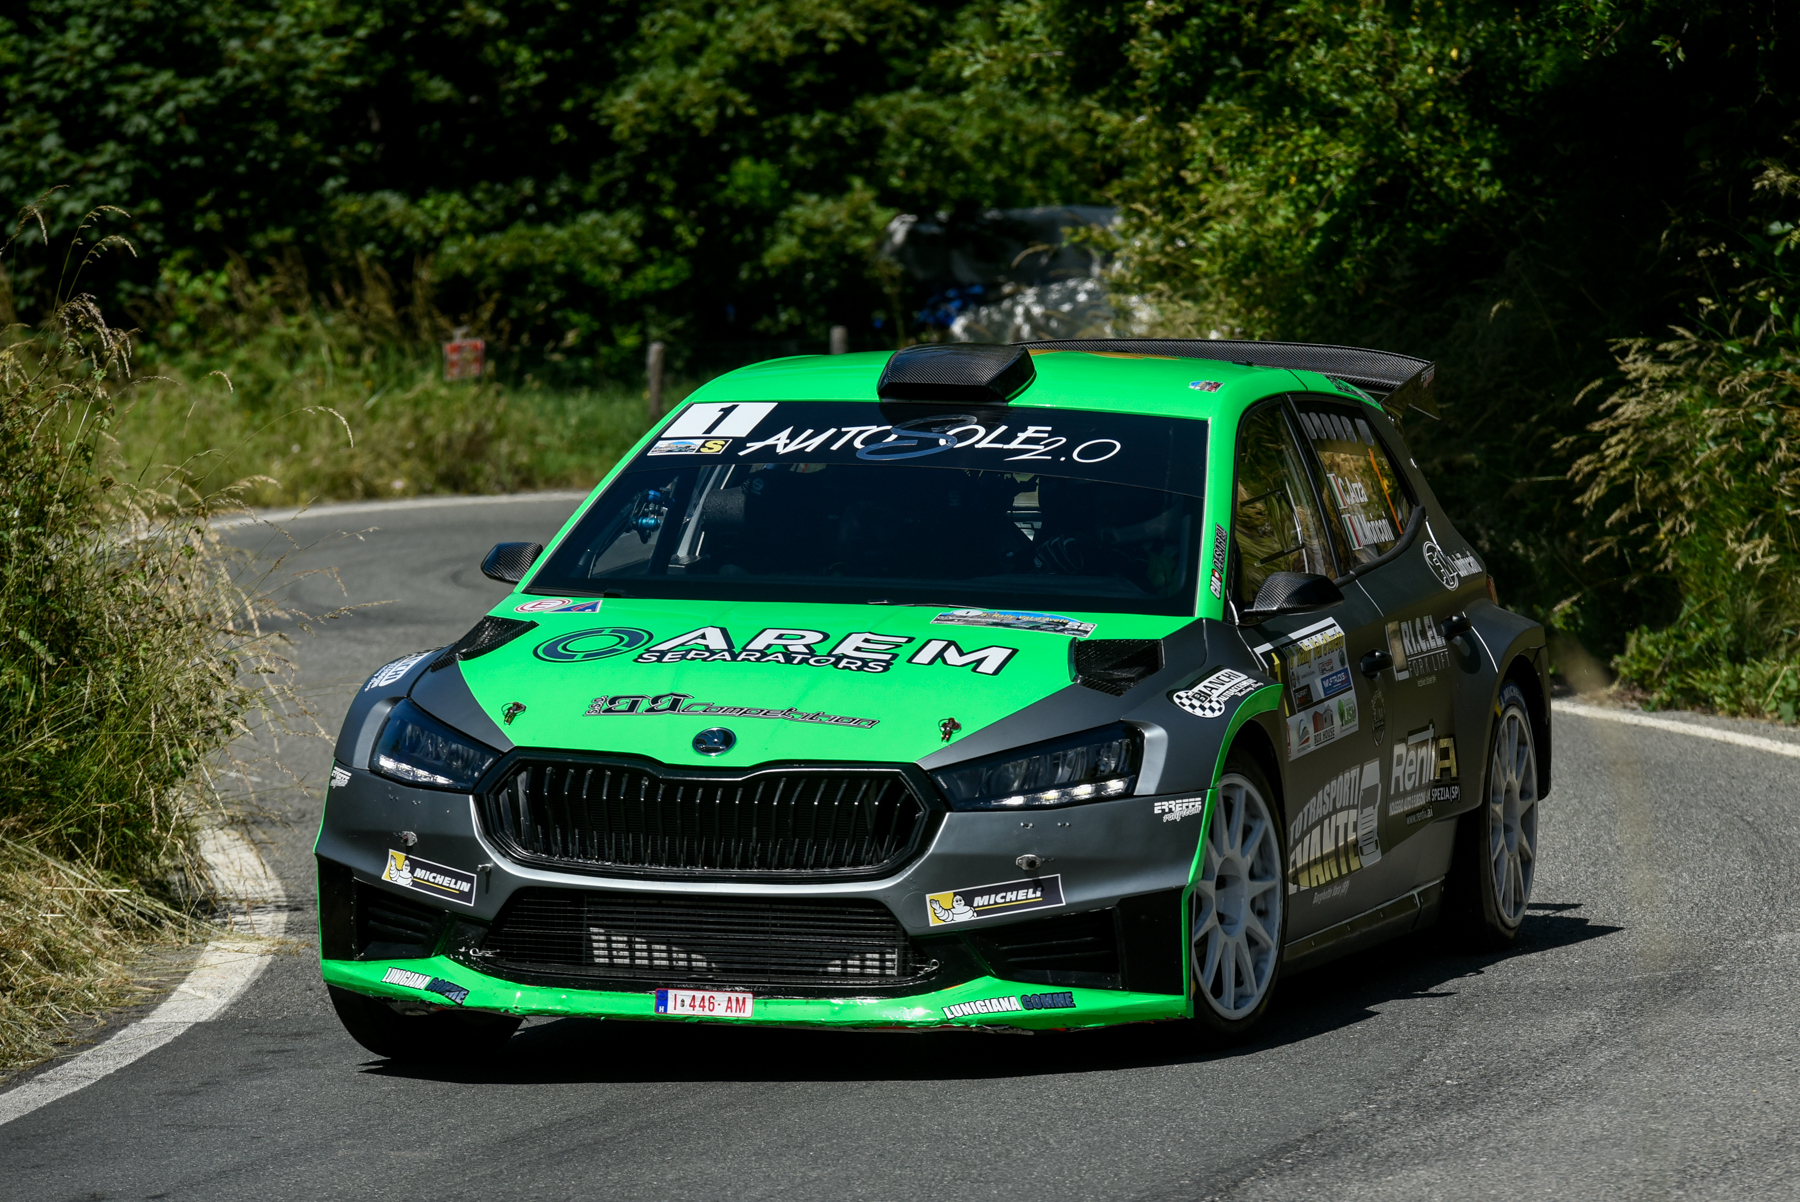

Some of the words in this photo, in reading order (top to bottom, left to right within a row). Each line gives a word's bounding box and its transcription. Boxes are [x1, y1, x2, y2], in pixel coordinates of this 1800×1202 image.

[702, 403, 741, 435] 1
[700, 440, 726, 453] S
[633, 649, 891, 674] SEPARATORS
[645, 626, 1018, 675] AREM
[1408, 656, 1431, 678] FORK
[1191, 671, 1242, 703] BIANCHI
[413, 868, 472, 893] MICHELIN
[381, 966, 432, 990] LUNIGIANA
[658, 1005, 665, 1013] H
[942, 995, 1022, 1020] LUNIGIANA
[1020, 991, 1076, 1011] GOMME
